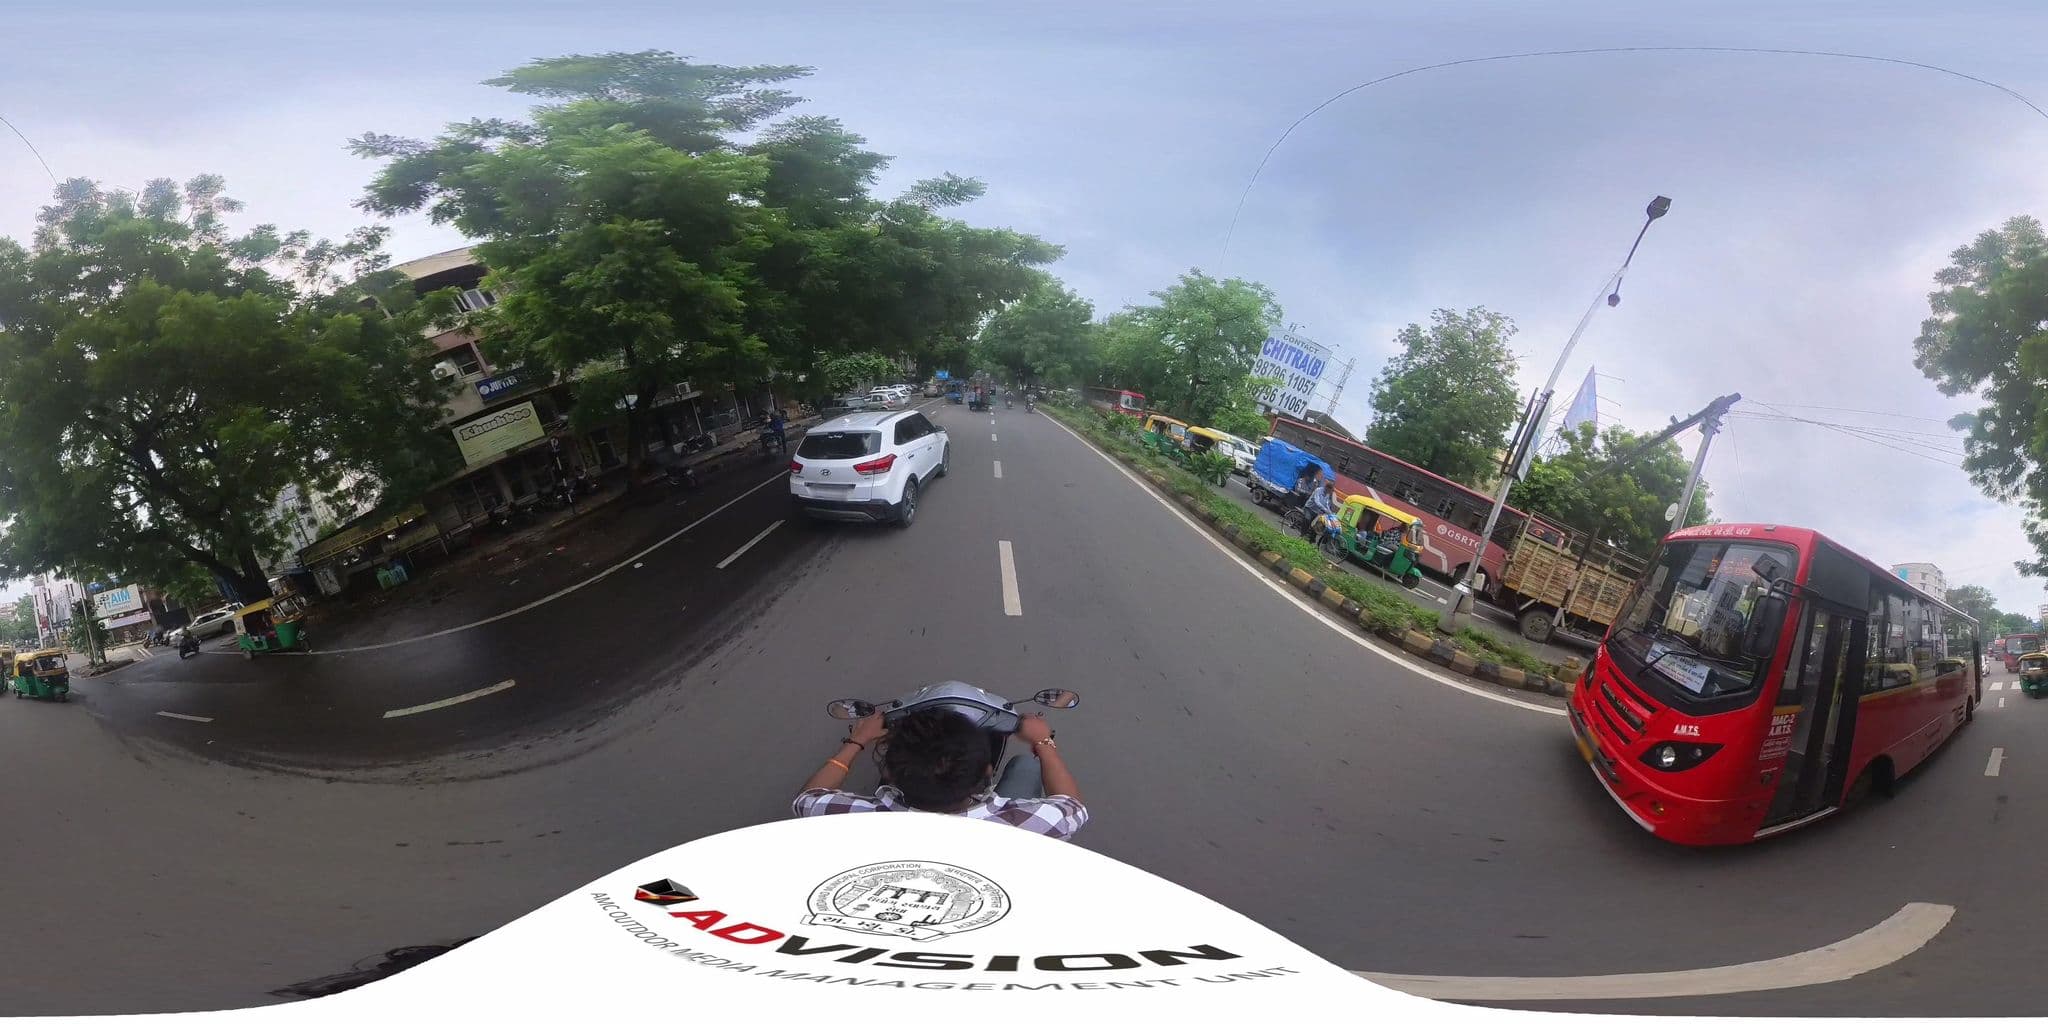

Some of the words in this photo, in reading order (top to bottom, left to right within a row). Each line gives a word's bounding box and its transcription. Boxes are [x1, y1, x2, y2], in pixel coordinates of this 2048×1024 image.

[1262, 337, 1325, 380] CHITRA(B)
[1283, 334, 1319, 354] CONTACT
[1254, 358, 1287, 379] 98796
[1288, 372, 1316, 395] 11057
[1278, 392, 1308, 414] 11067
